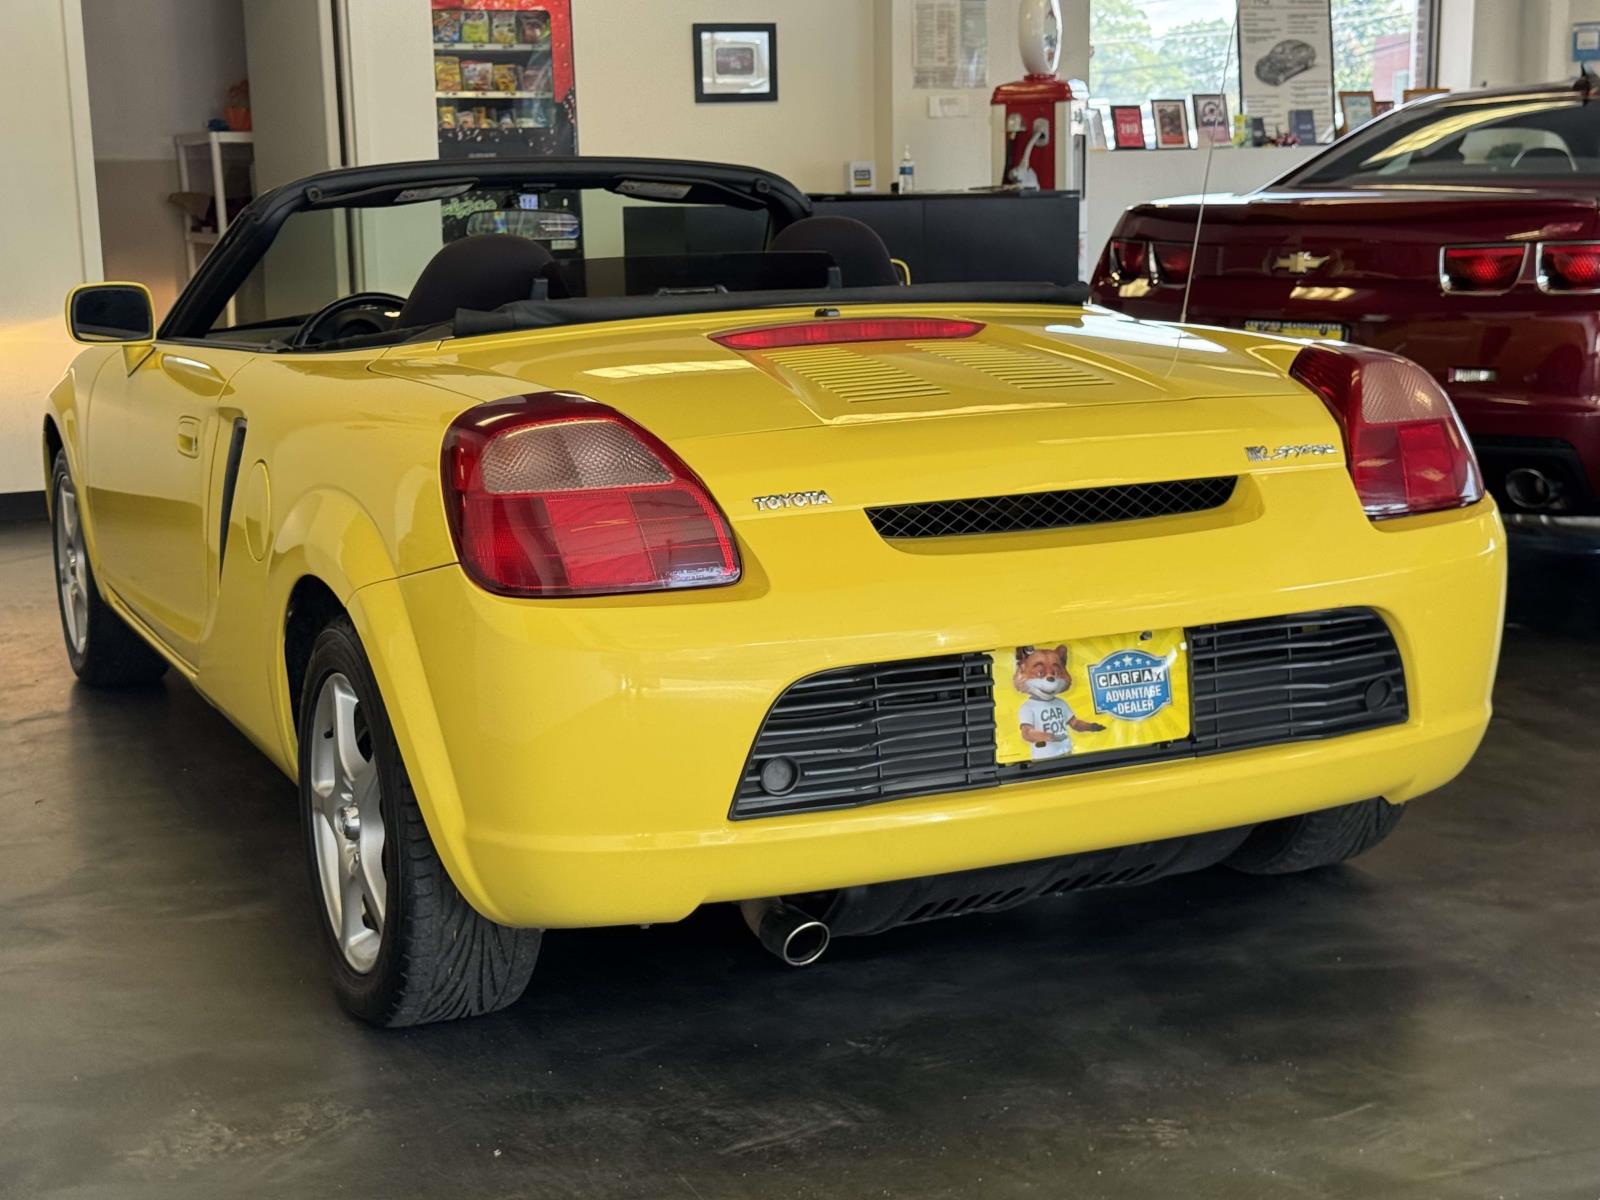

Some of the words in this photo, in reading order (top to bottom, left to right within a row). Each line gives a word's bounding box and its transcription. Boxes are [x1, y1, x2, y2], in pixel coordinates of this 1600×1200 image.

[752, 490, 833, 511] TOYOTA
[1098, 668, 1165, 688] CARFAX
[1106, 685, 1162, 703] ADVANTAGE
[1041, 707, 1063, 721] CAR
[1117, 700, 1155, 714] DEALER
[1043, 720, 1067, 733] FOX
